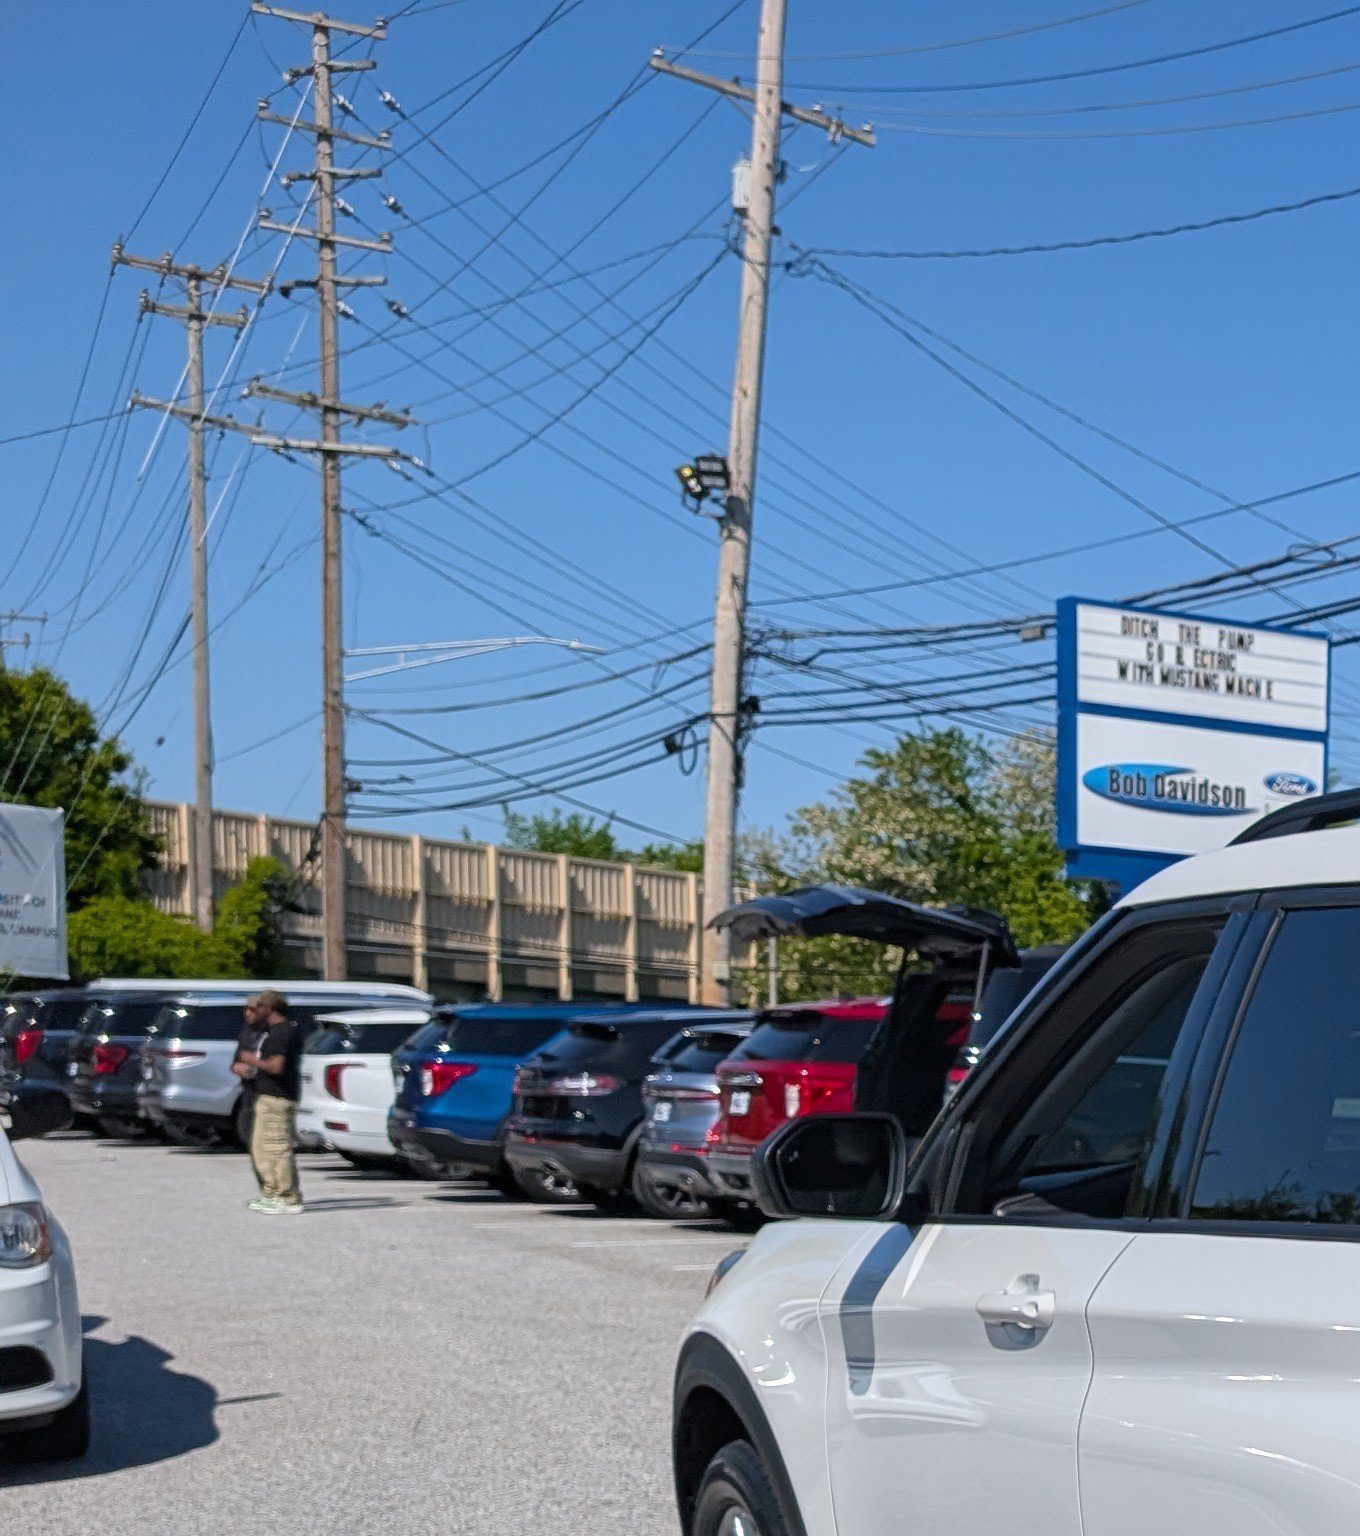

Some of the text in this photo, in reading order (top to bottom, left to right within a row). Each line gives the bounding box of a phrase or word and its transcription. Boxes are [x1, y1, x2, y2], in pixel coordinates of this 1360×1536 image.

[1121, 615, 1255, 652] DITCH THE PUMP
[1146, 641, 1164, 663] GO
[1118, 658, 1154, 684] WITH
[1160, 665, 1219, 692] MUSTANG
[1225, 675, 1261, 699] MACH
[1108, 766, 1247, 809] Bob Davidson
[1269, 774, 1312, 795] Ford
